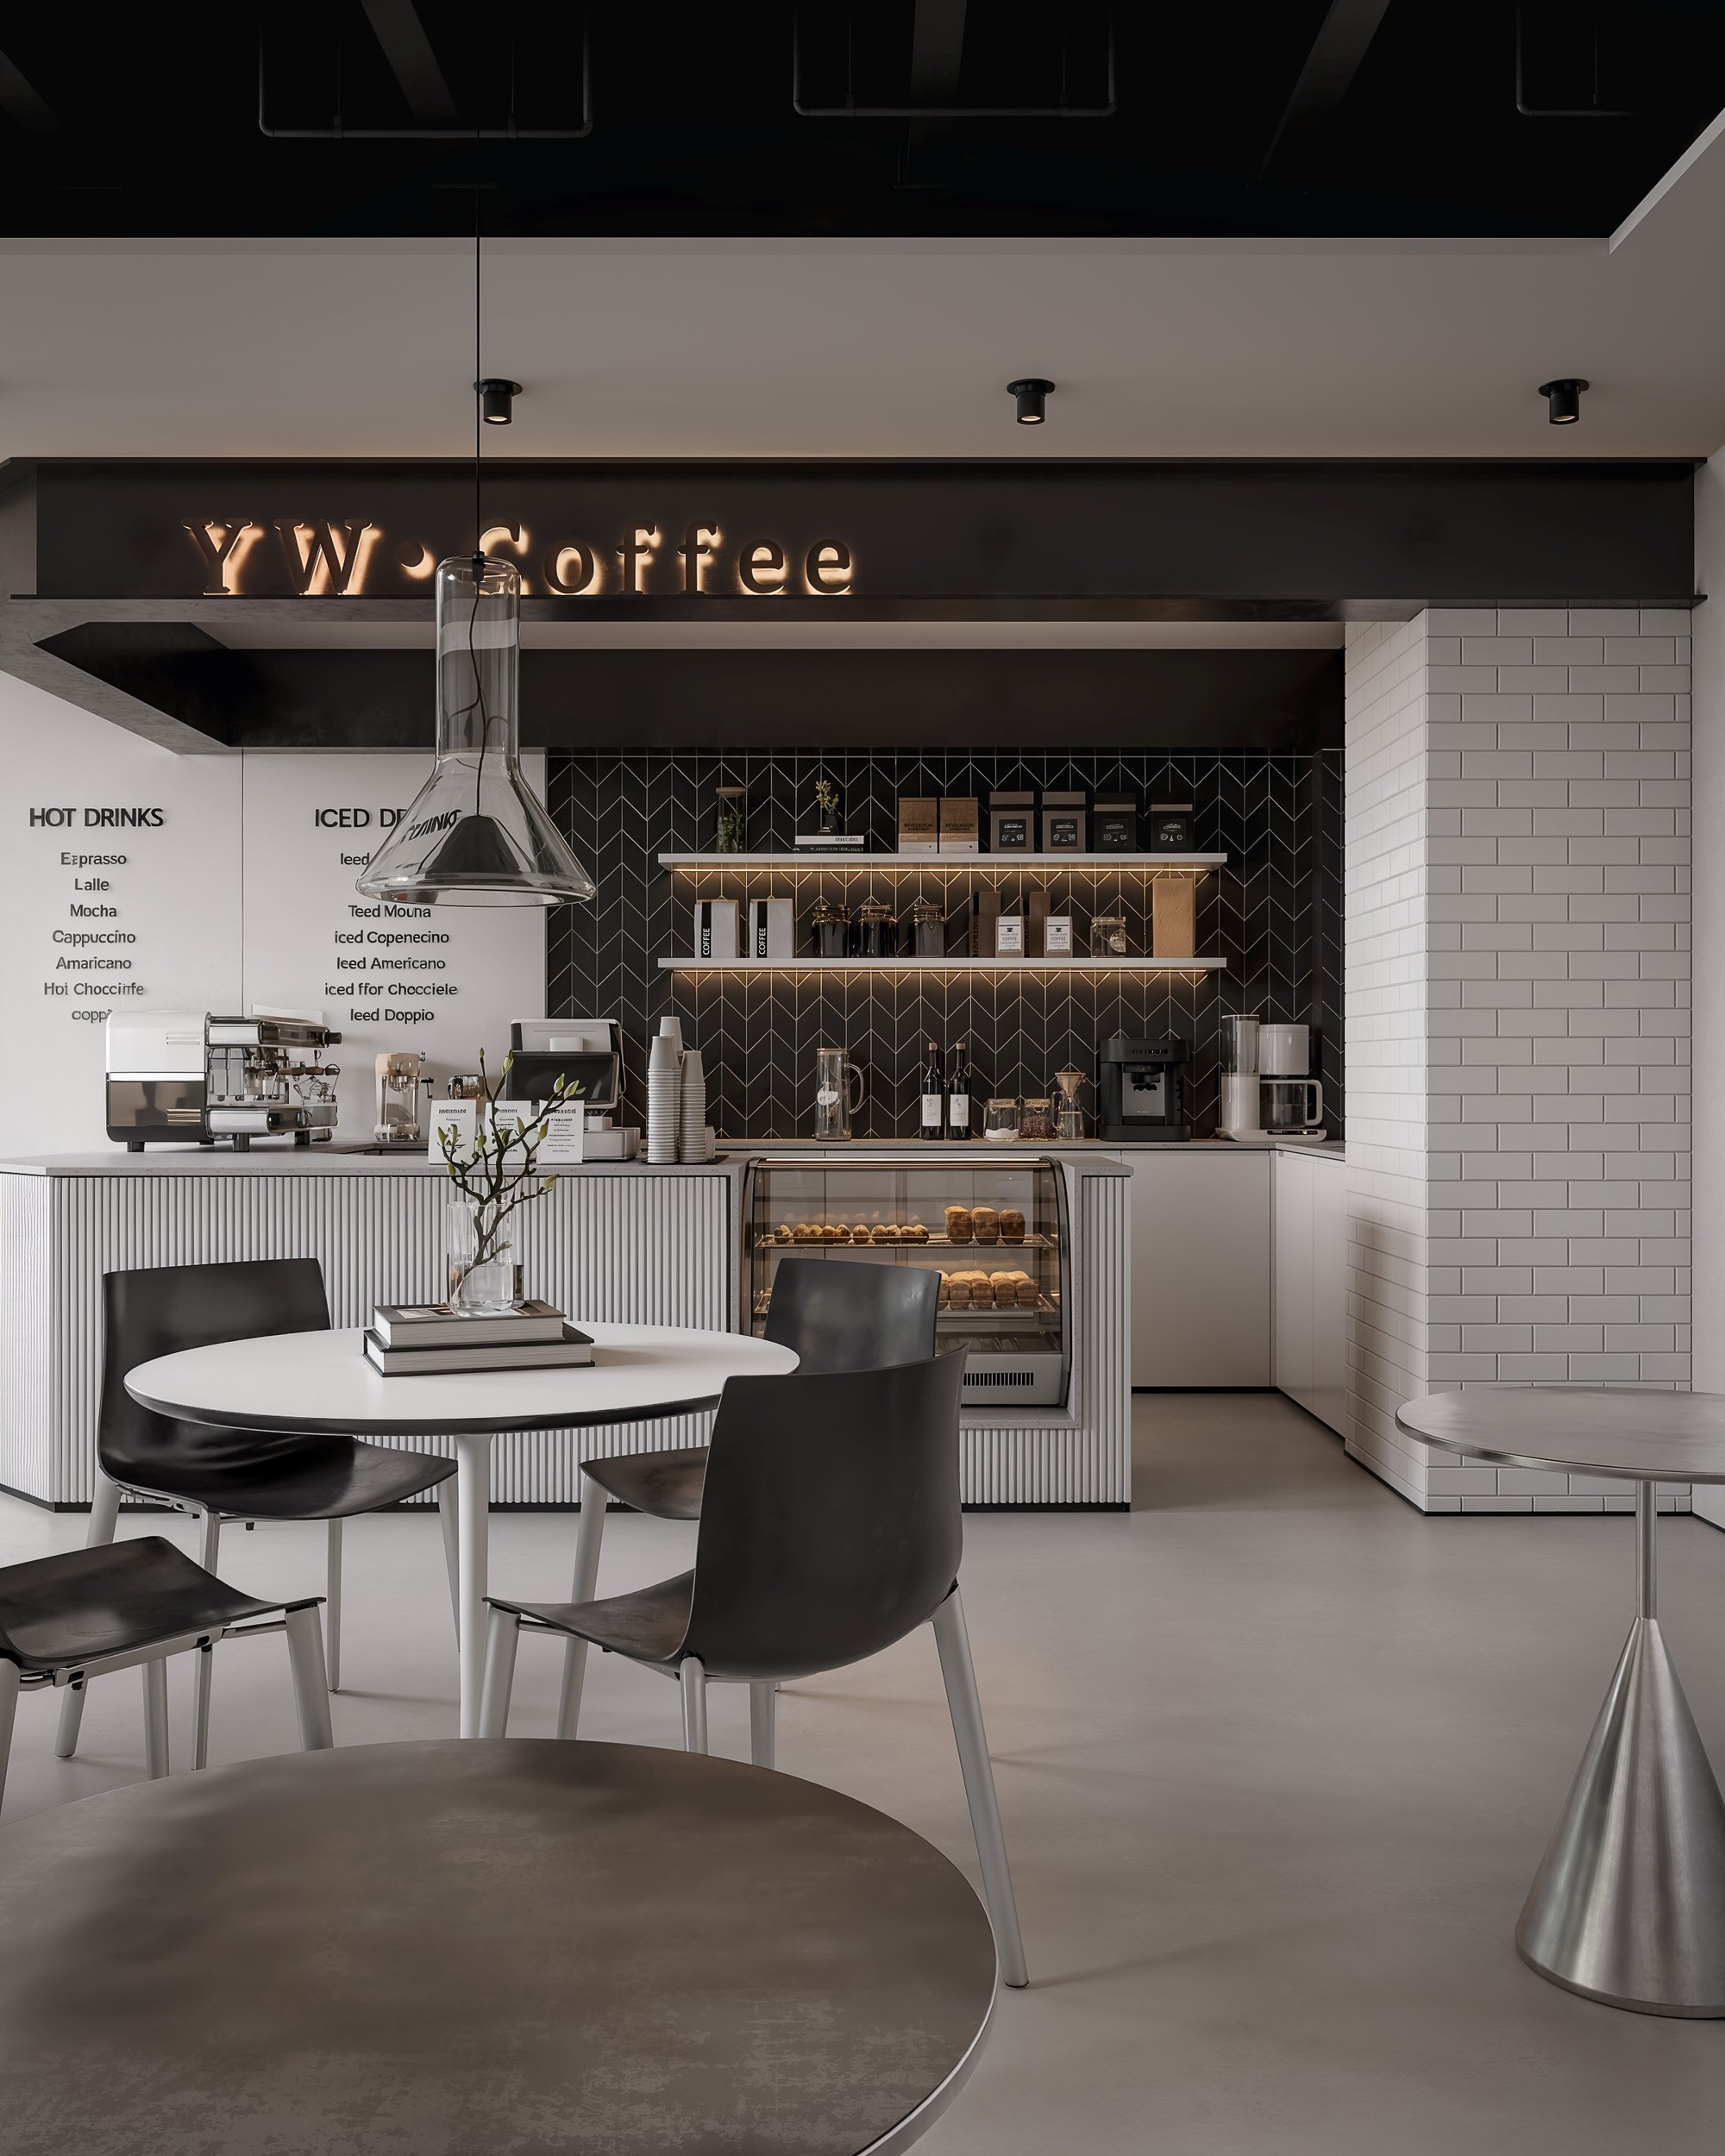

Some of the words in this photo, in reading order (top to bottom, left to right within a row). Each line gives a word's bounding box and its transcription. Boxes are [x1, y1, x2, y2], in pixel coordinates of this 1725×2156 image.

[467, 518, 852, 595] Coffee
[29, 807, 77, 827] HOT
[84, 807, 164, 827] DRINKS
[315, 808, 371, 828] ICED
[70, 903, 117, 918] Mocha
[334, 930, 364, 943] iced
[702, 928, 711, 956] COFFEE
[370, 956, 446, 969] Americano
[324, 982, 354, 995] iced
[385, 1009, 435, 1025] Doppio
